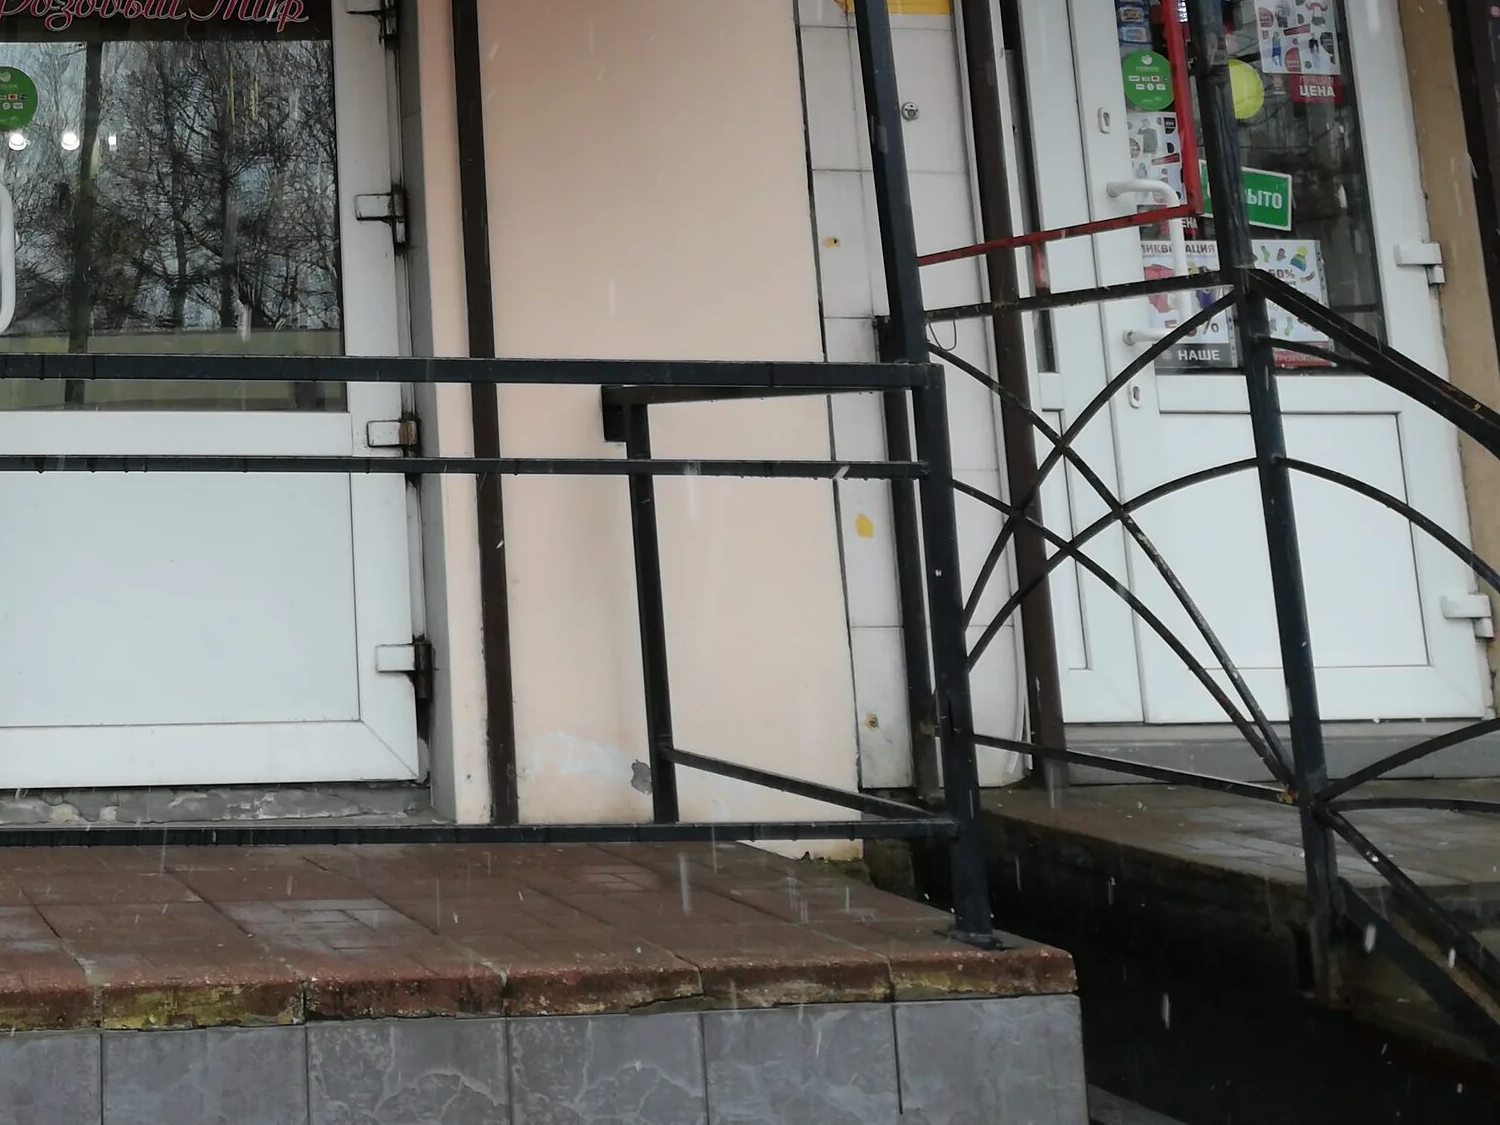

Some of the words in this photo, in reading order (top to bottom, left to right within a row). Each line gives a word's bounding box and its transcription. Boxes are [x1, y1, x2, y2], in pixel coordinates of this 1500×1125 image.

[1299, 85, 1336, 98] ЦЕНА
[1141, 243, 1216, 255] ЛИКВАЦИЯ
[1177, 349, 1221, 362] НАШЕ
